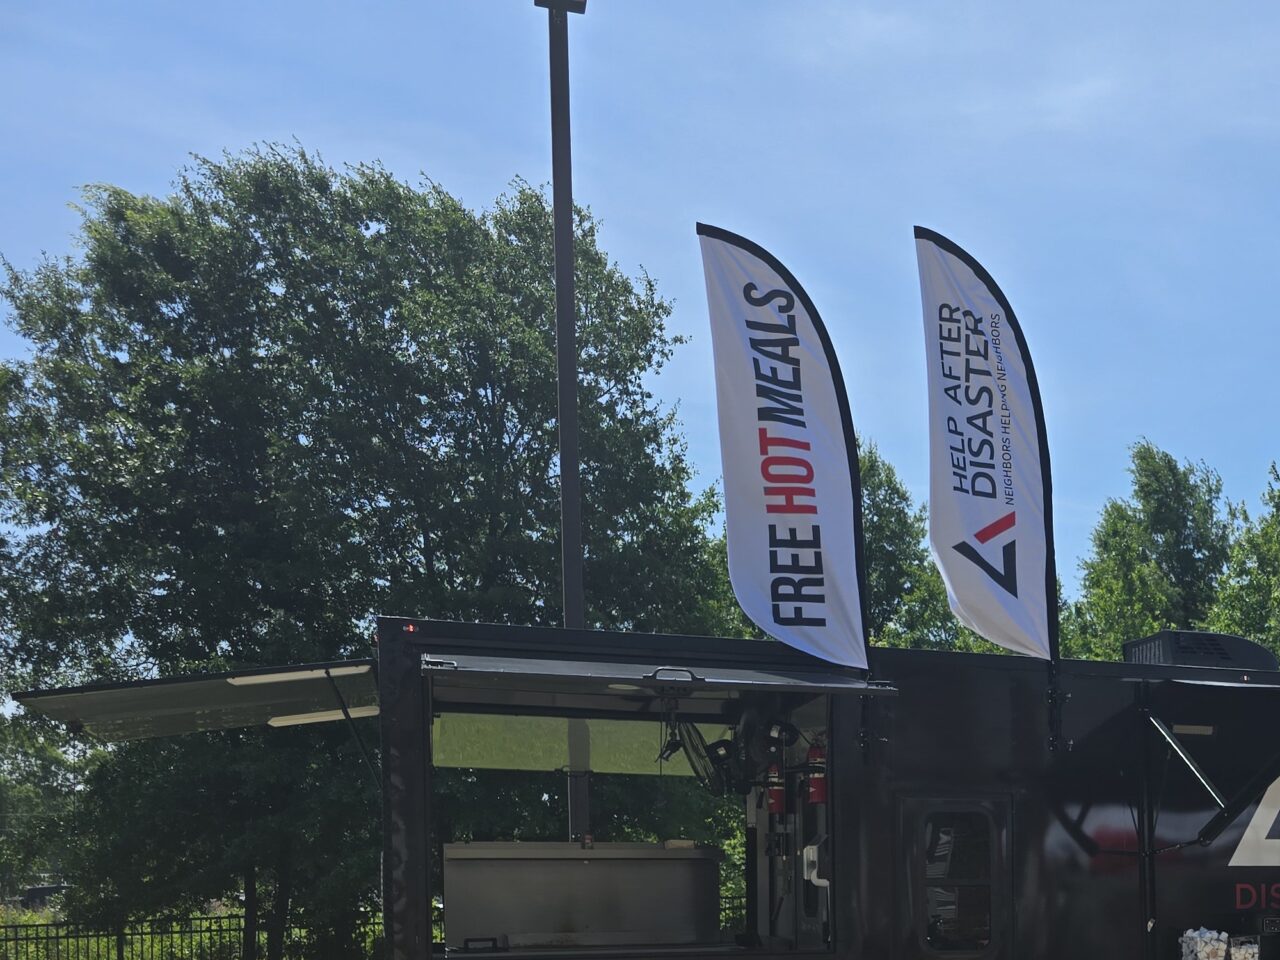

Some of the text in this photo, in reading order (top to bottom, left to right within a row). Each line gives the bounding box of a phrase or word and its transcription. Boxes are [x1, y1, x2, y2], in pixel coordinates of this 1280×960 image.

[742, 281, 827, 627] FREE HOT MEALS
[939, 303, 970, 494] HELP AFTER
[962, 309, 997, 499] DISASTER
[1001, 437, 1014, 505] NEIGHBORS
